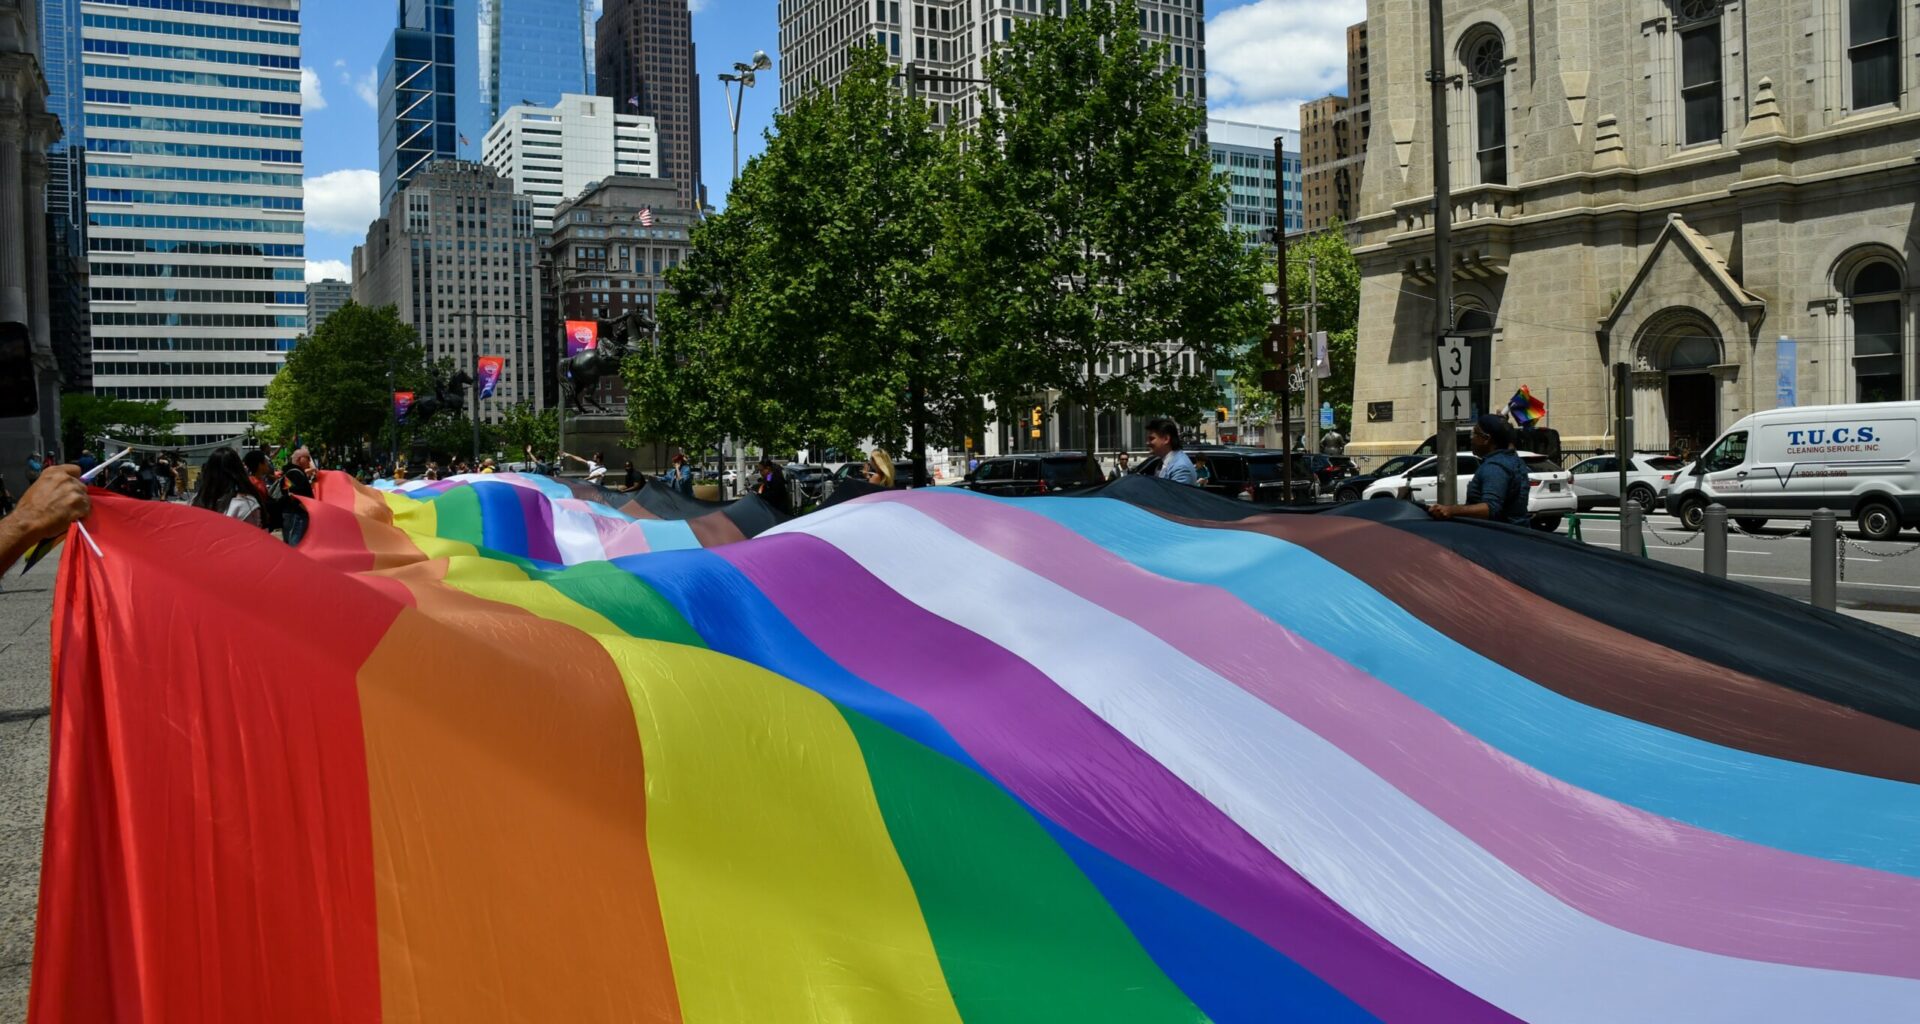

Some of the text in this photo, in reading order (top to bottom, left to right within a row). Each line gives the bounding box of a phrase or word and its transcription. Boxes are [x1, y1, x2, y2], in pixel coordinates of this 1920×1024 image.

[1450, 347, 1462, 375] 3
[1787, 427, 1880, 445] T.U.C.S.
[1787, 446, 1825, 454] CLEANING
[1864, 444, 1880, 452] INC.
